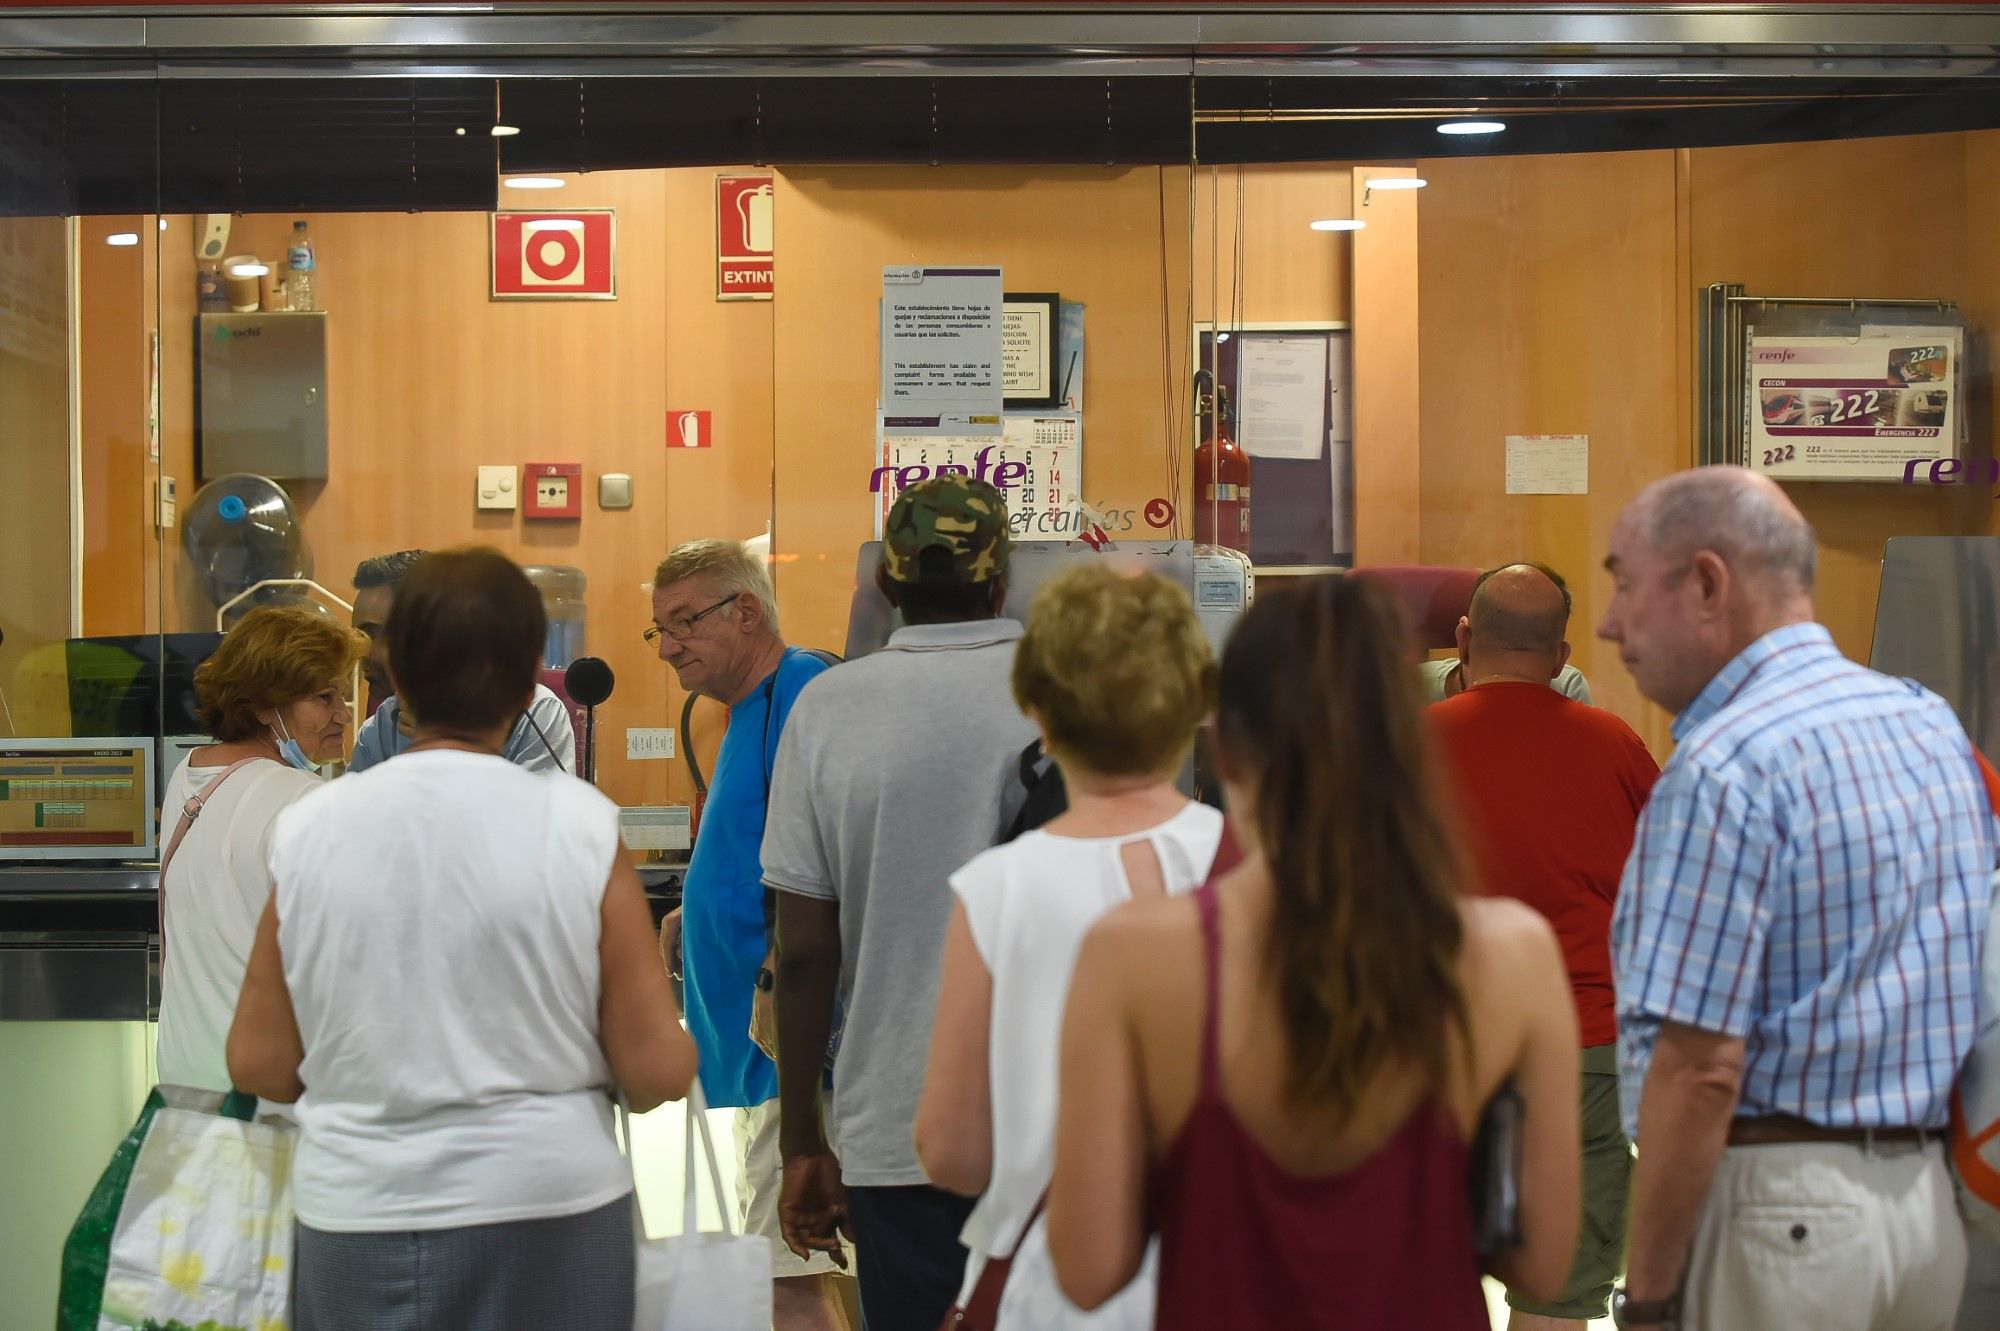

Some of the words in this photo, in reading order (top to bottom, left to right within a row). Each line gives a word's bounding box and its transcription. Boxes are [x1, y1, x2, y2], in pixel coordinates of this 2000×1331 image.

[1759, 349, 1796, 363] renfe
[1910, 347, 1935, 363] 222
[1763, 379, 1786, 387] CECON
[1829, 390, 1880, 423] 222
[1917, 428, 1936, 437] 222
[920, 448, 927, 464] 2
[947, 449, 953, 464] 3
[1026, 450, 1032, 466] 6
[1052, 451, 1058, 466] 7
[1763, 444, 1795, 466] 222
[869, 445, 1027, 493] renfe
[1903, 457, 2000, 486] ren
[1049, 470, 1061, 485] 14
[1022, 488, 1035, 503] 20
[1049, 488, 1060, 504] 21
